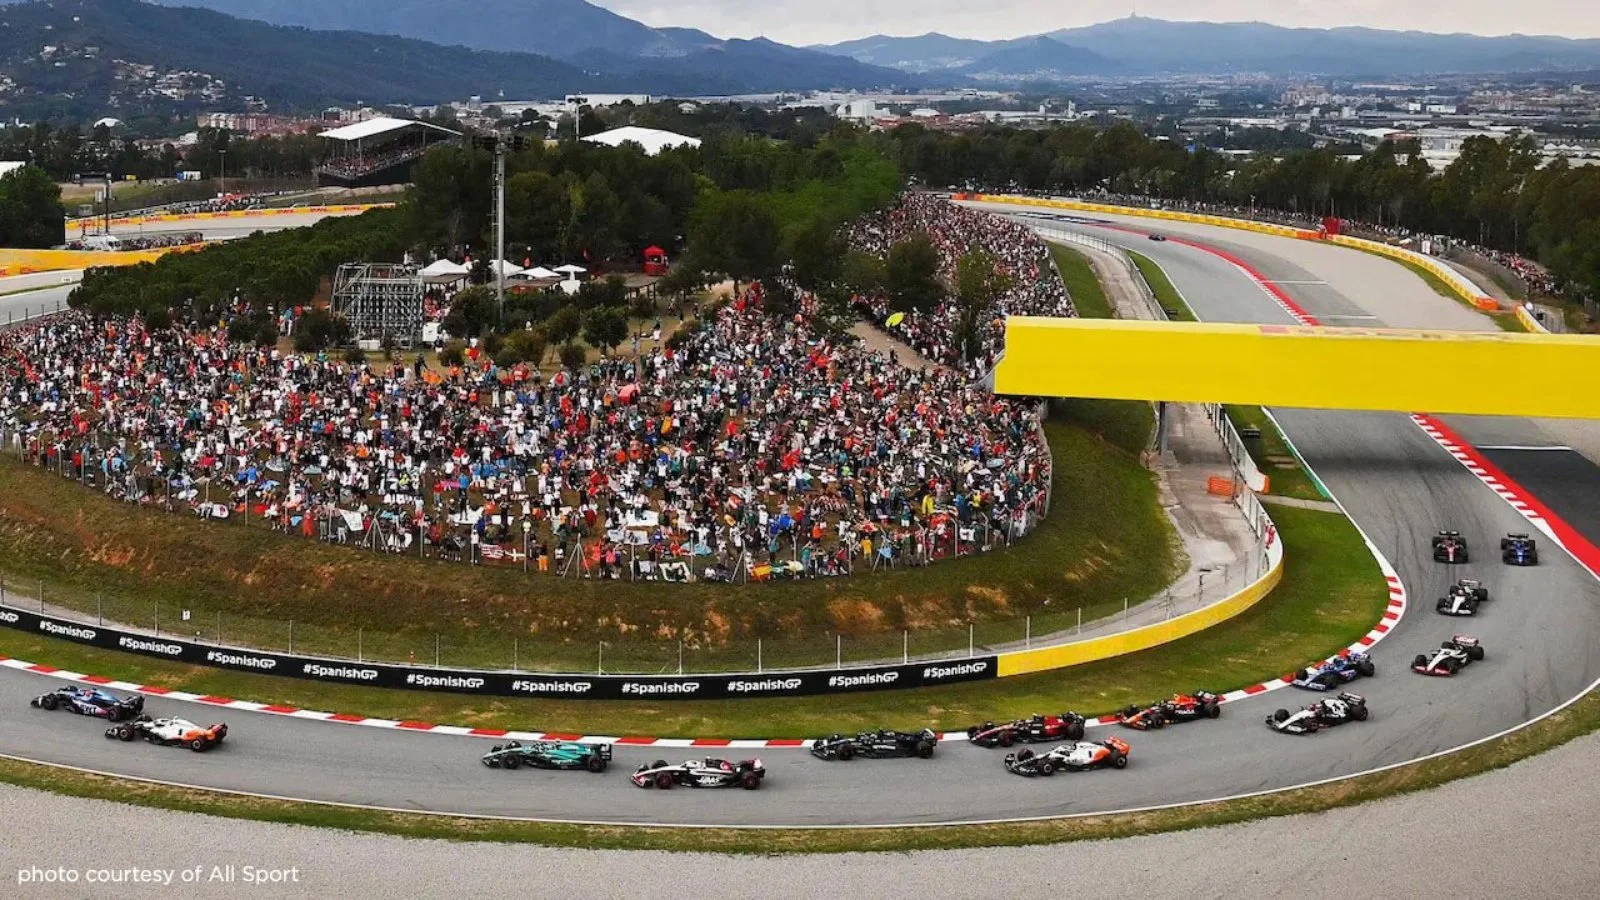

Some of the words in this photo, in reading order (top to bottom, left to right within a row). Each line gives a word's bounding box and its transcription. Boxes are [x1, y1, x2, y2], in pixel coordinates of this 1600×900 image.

[40, 621, 96, 639] #SpanishGP
[120, 637, 182, 655] #SpanishGP
[208, 651, 277, 668] #SpanishGP
[303, 664, 378, 680] #SpanishGP
[924, 662, 987, 678] #SpanishGP
[407, 674, 485, 689] #SpanishGP
[513, 681, 592, 693] #SpanishGP
[728, 679, 802, 692] #SpanishGP
[829, 672, 899, 688] #SpanishGP
[622, 683, 700, 694] #SpanishGP
